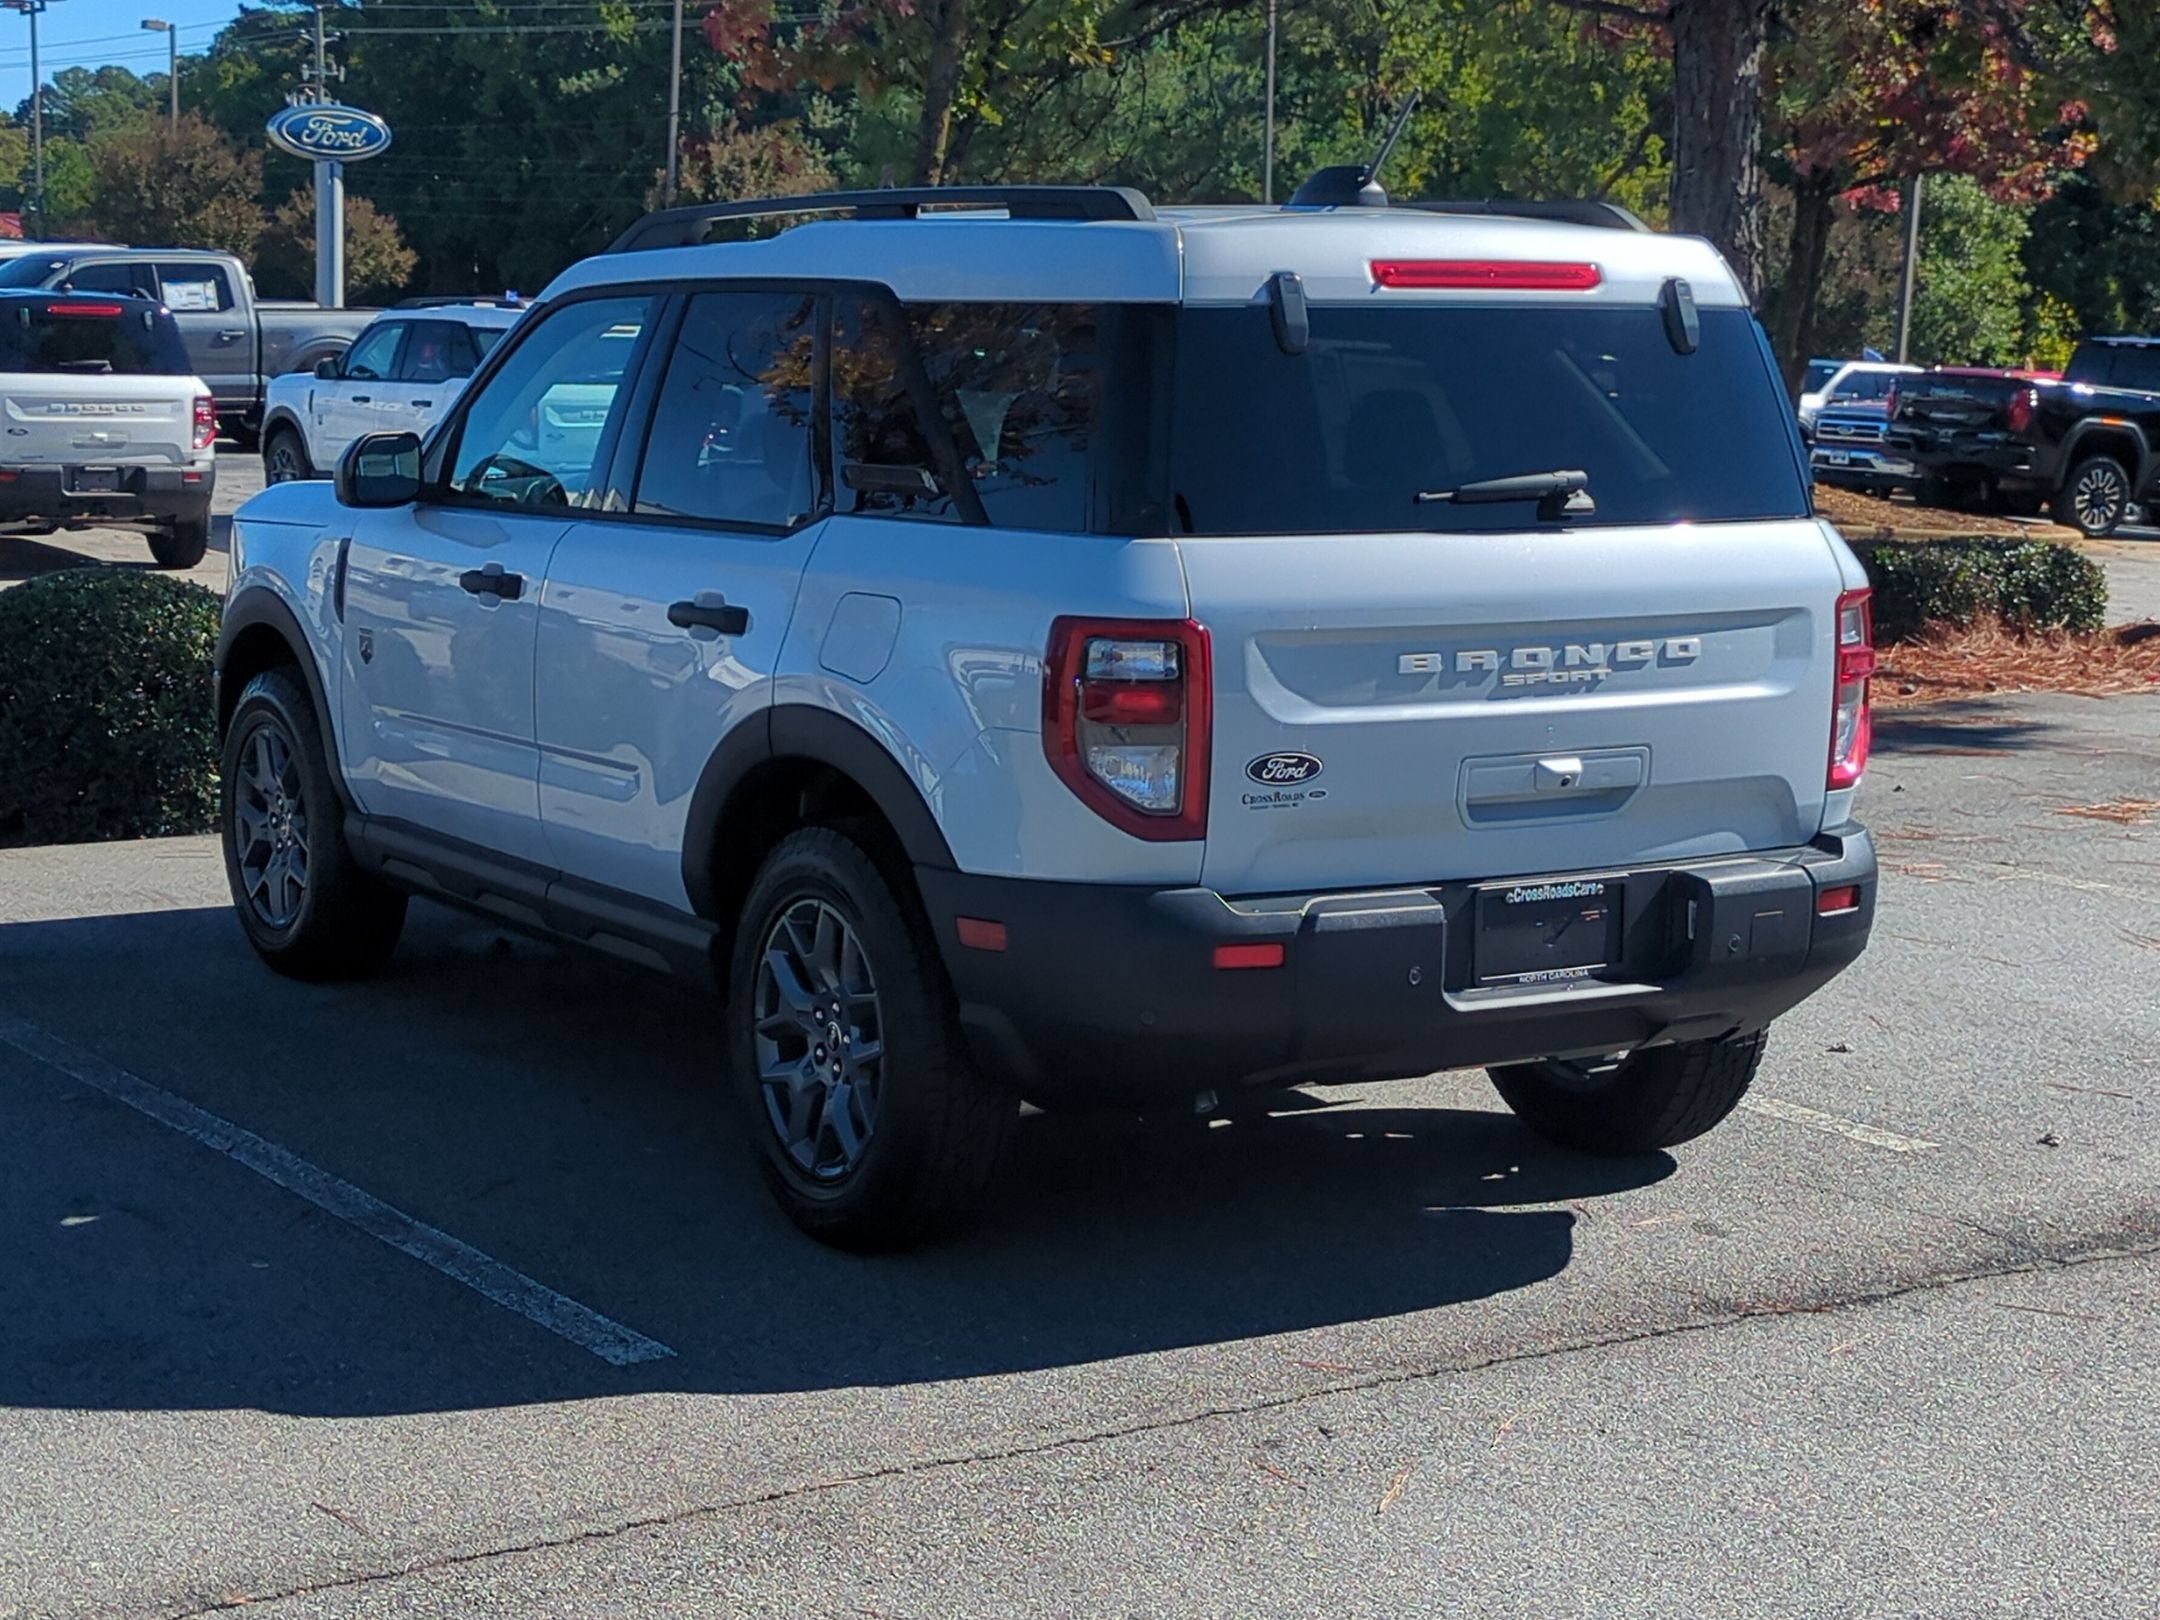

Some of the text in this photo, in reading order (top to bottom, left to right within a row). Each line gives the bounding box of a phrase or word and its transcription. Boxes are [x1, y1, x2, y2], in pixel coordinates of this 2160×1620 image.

[301, 116, 368, 147] Ford
[1398, 638, 1700, 674] BRONCO
[1503, 668, 1612, 687] SPORT
[1262, 757, 1310, 779] Ford
[1519, 969, 1589, 983] NORTH CAROLINA
